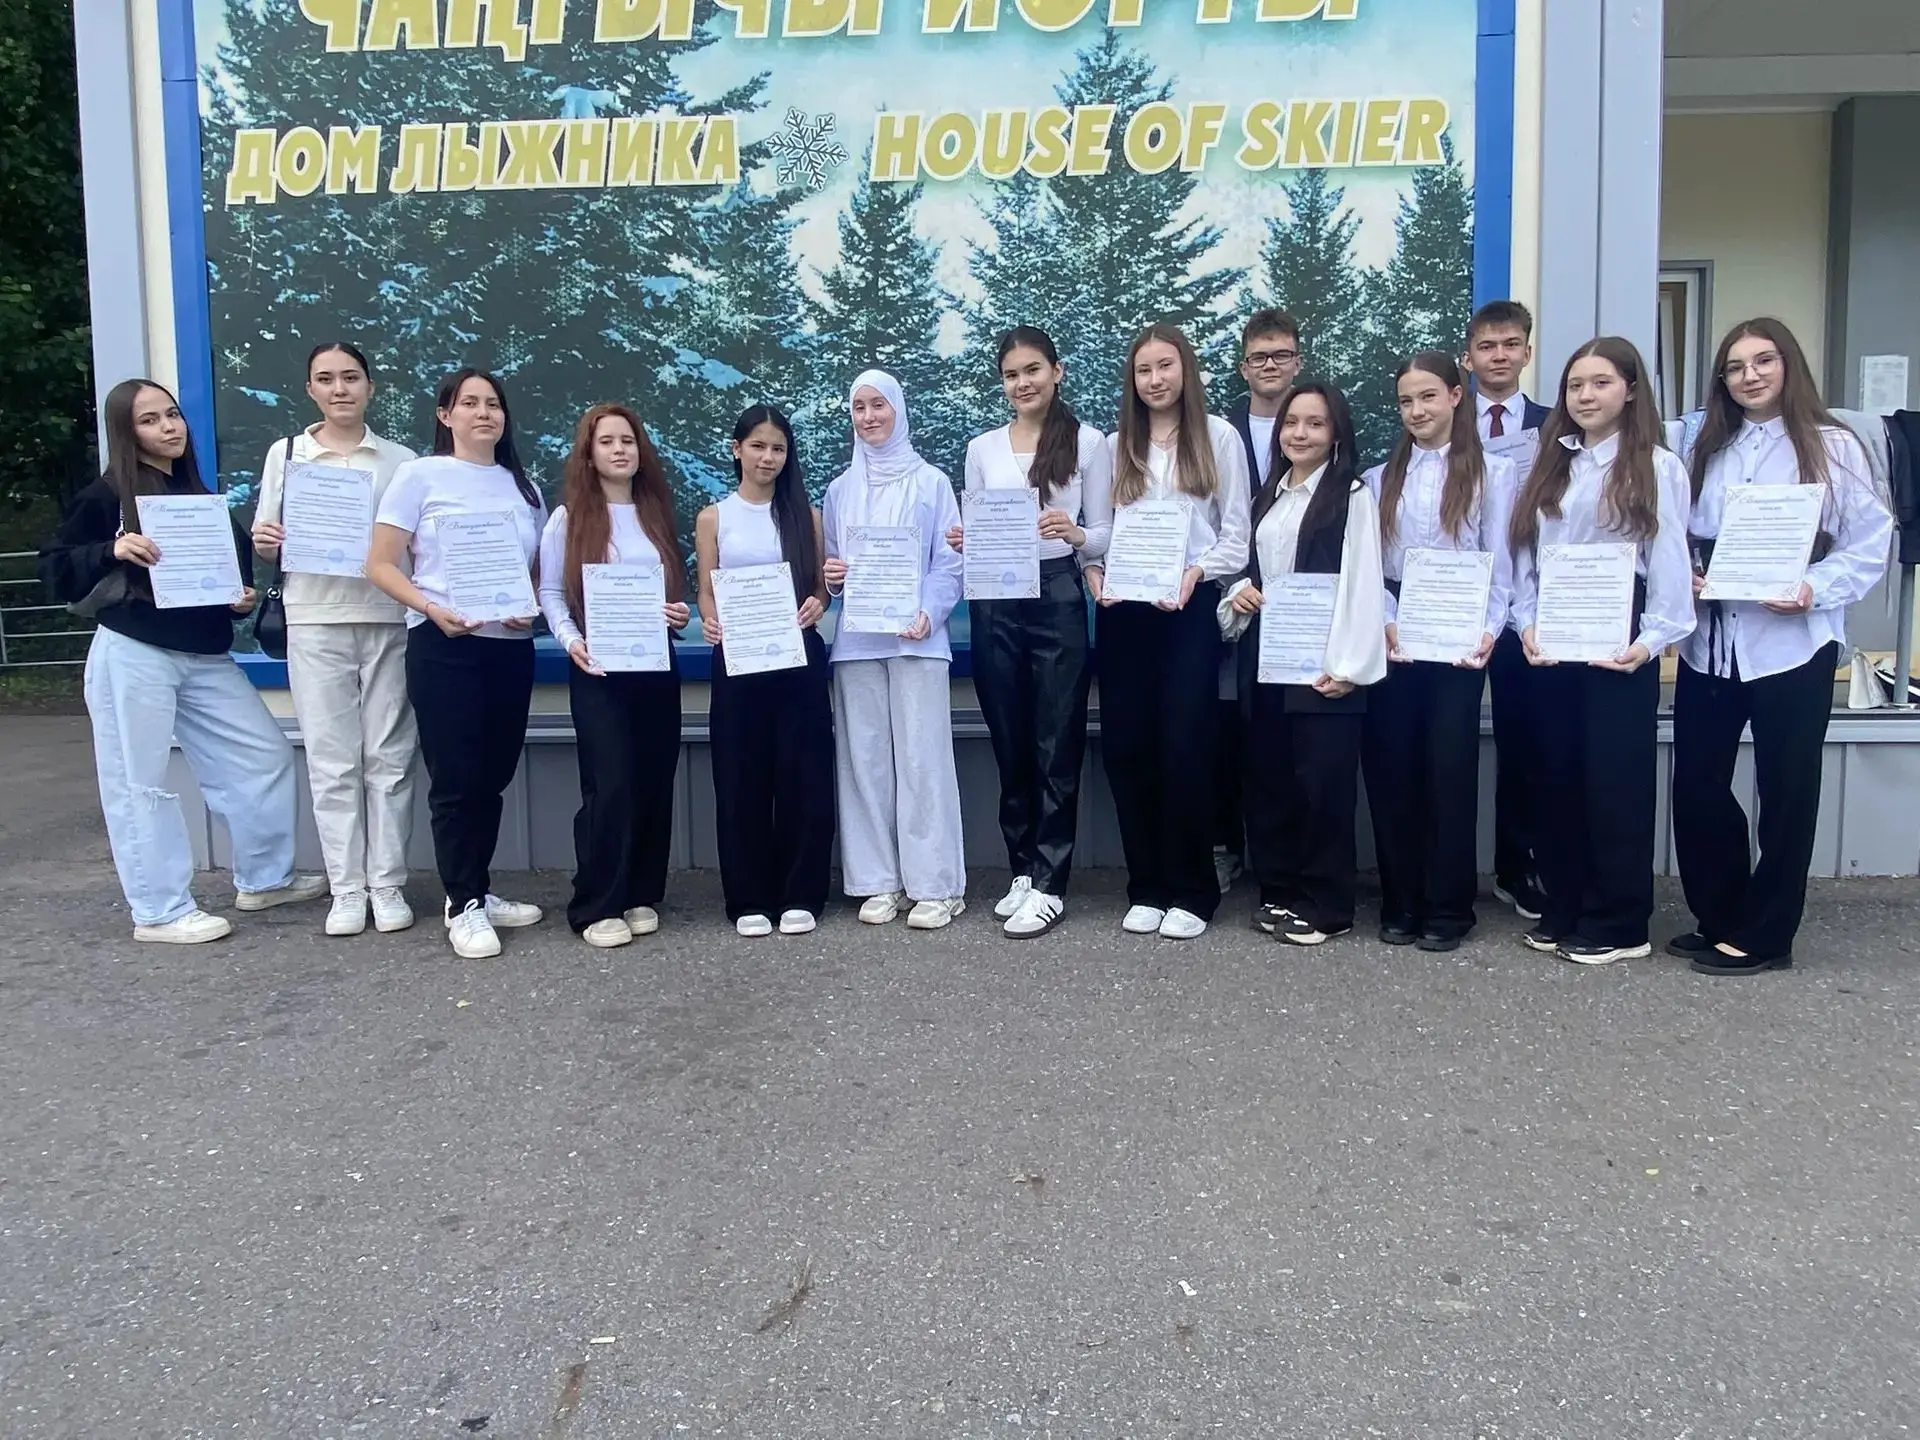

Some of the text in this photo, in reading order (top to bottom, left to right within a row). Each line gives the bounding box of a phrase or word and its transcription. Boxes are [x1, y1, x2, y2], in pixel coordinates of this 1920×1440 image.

[226, 115, 740, 205] ДОМ ЛЫЖНИКА
[869, 95, 1450, 182] HOUSE OF SKIER
